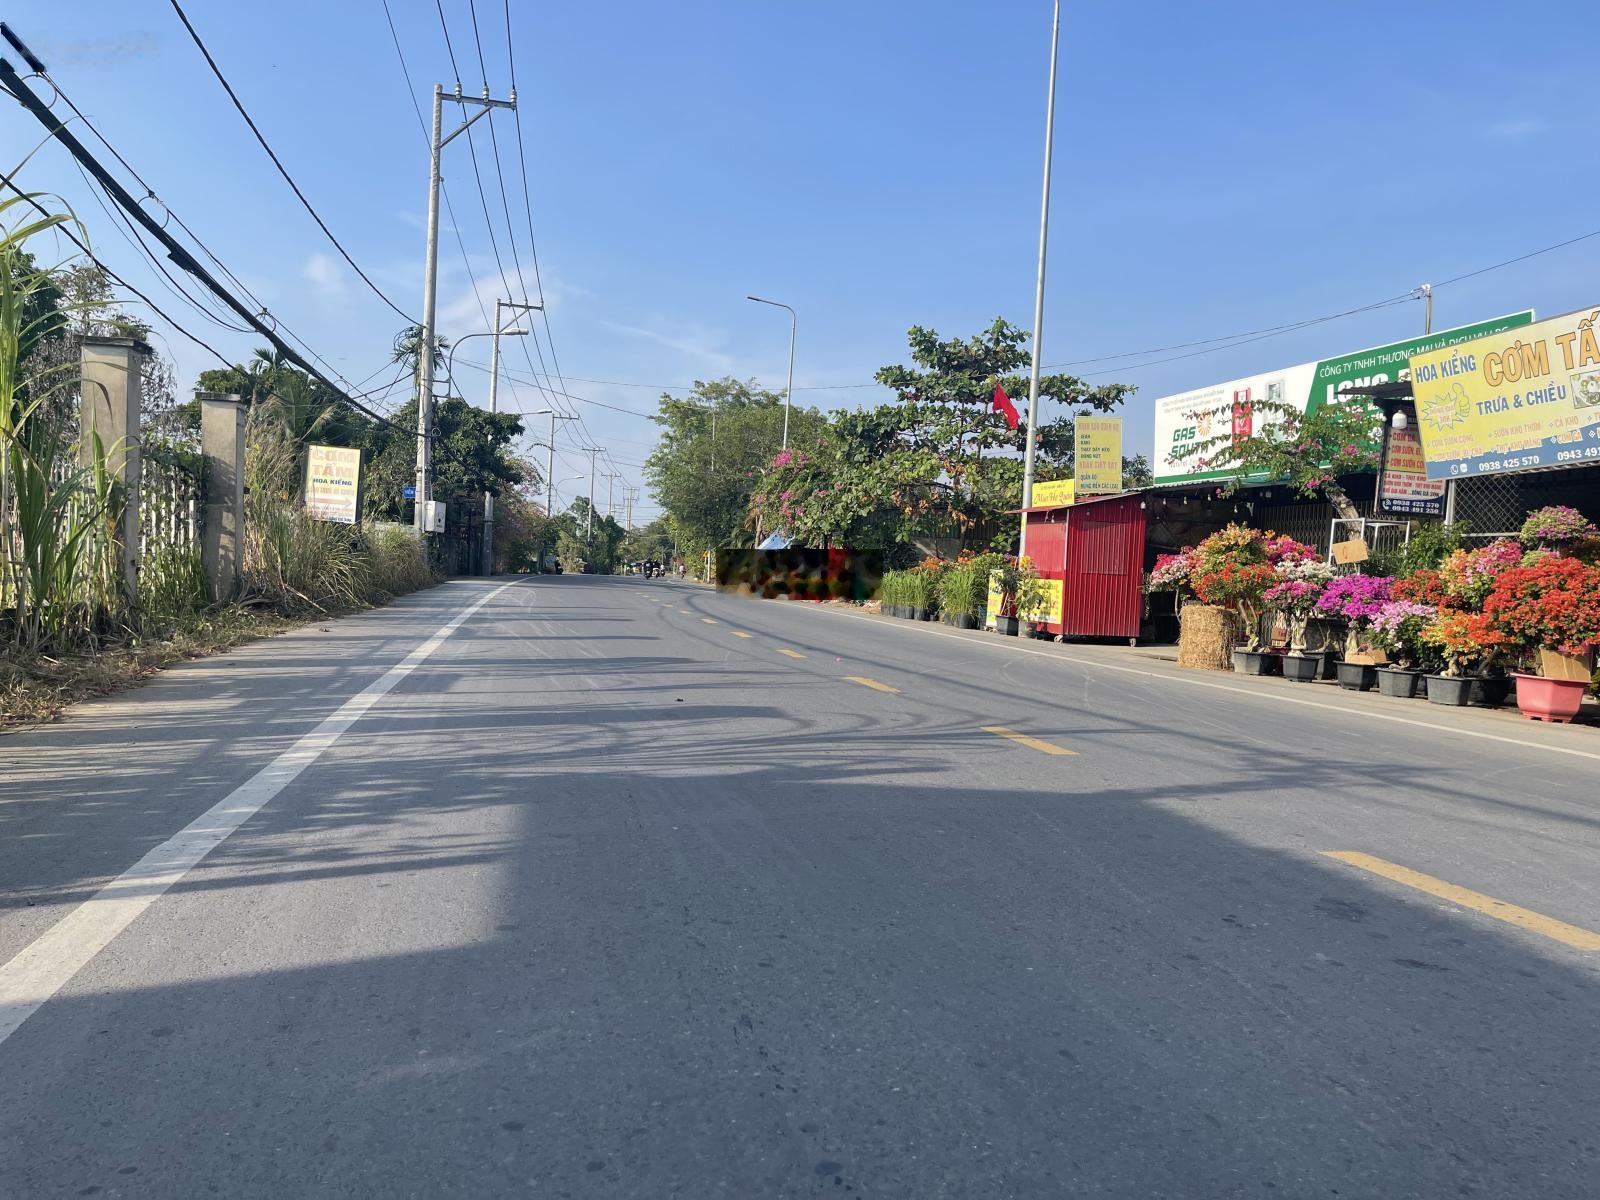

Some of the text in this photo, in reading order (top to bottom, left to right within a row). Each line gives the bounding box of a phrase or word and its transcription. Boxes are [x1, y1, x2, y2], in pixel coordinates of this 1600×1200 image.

[1483, 311, 1600, 387] CƠM TẤ
[1319, 364, 1342, 378] CÔNG
[1343, 362, 1352, 373] TY
[1354, 356, 1376, 371] TNHH
[1415, 364, 1438, 383] HOA
[1441, 349, 1476, 377] KIỂNG
[1476, 381, 1566, 415] TRƯA & CHIỀU
[1173, 426, 1196, 443] GAS
[1479, 456, 1539, 471] 0938 425 570
[1557, 450, 1582, 460] 0943
